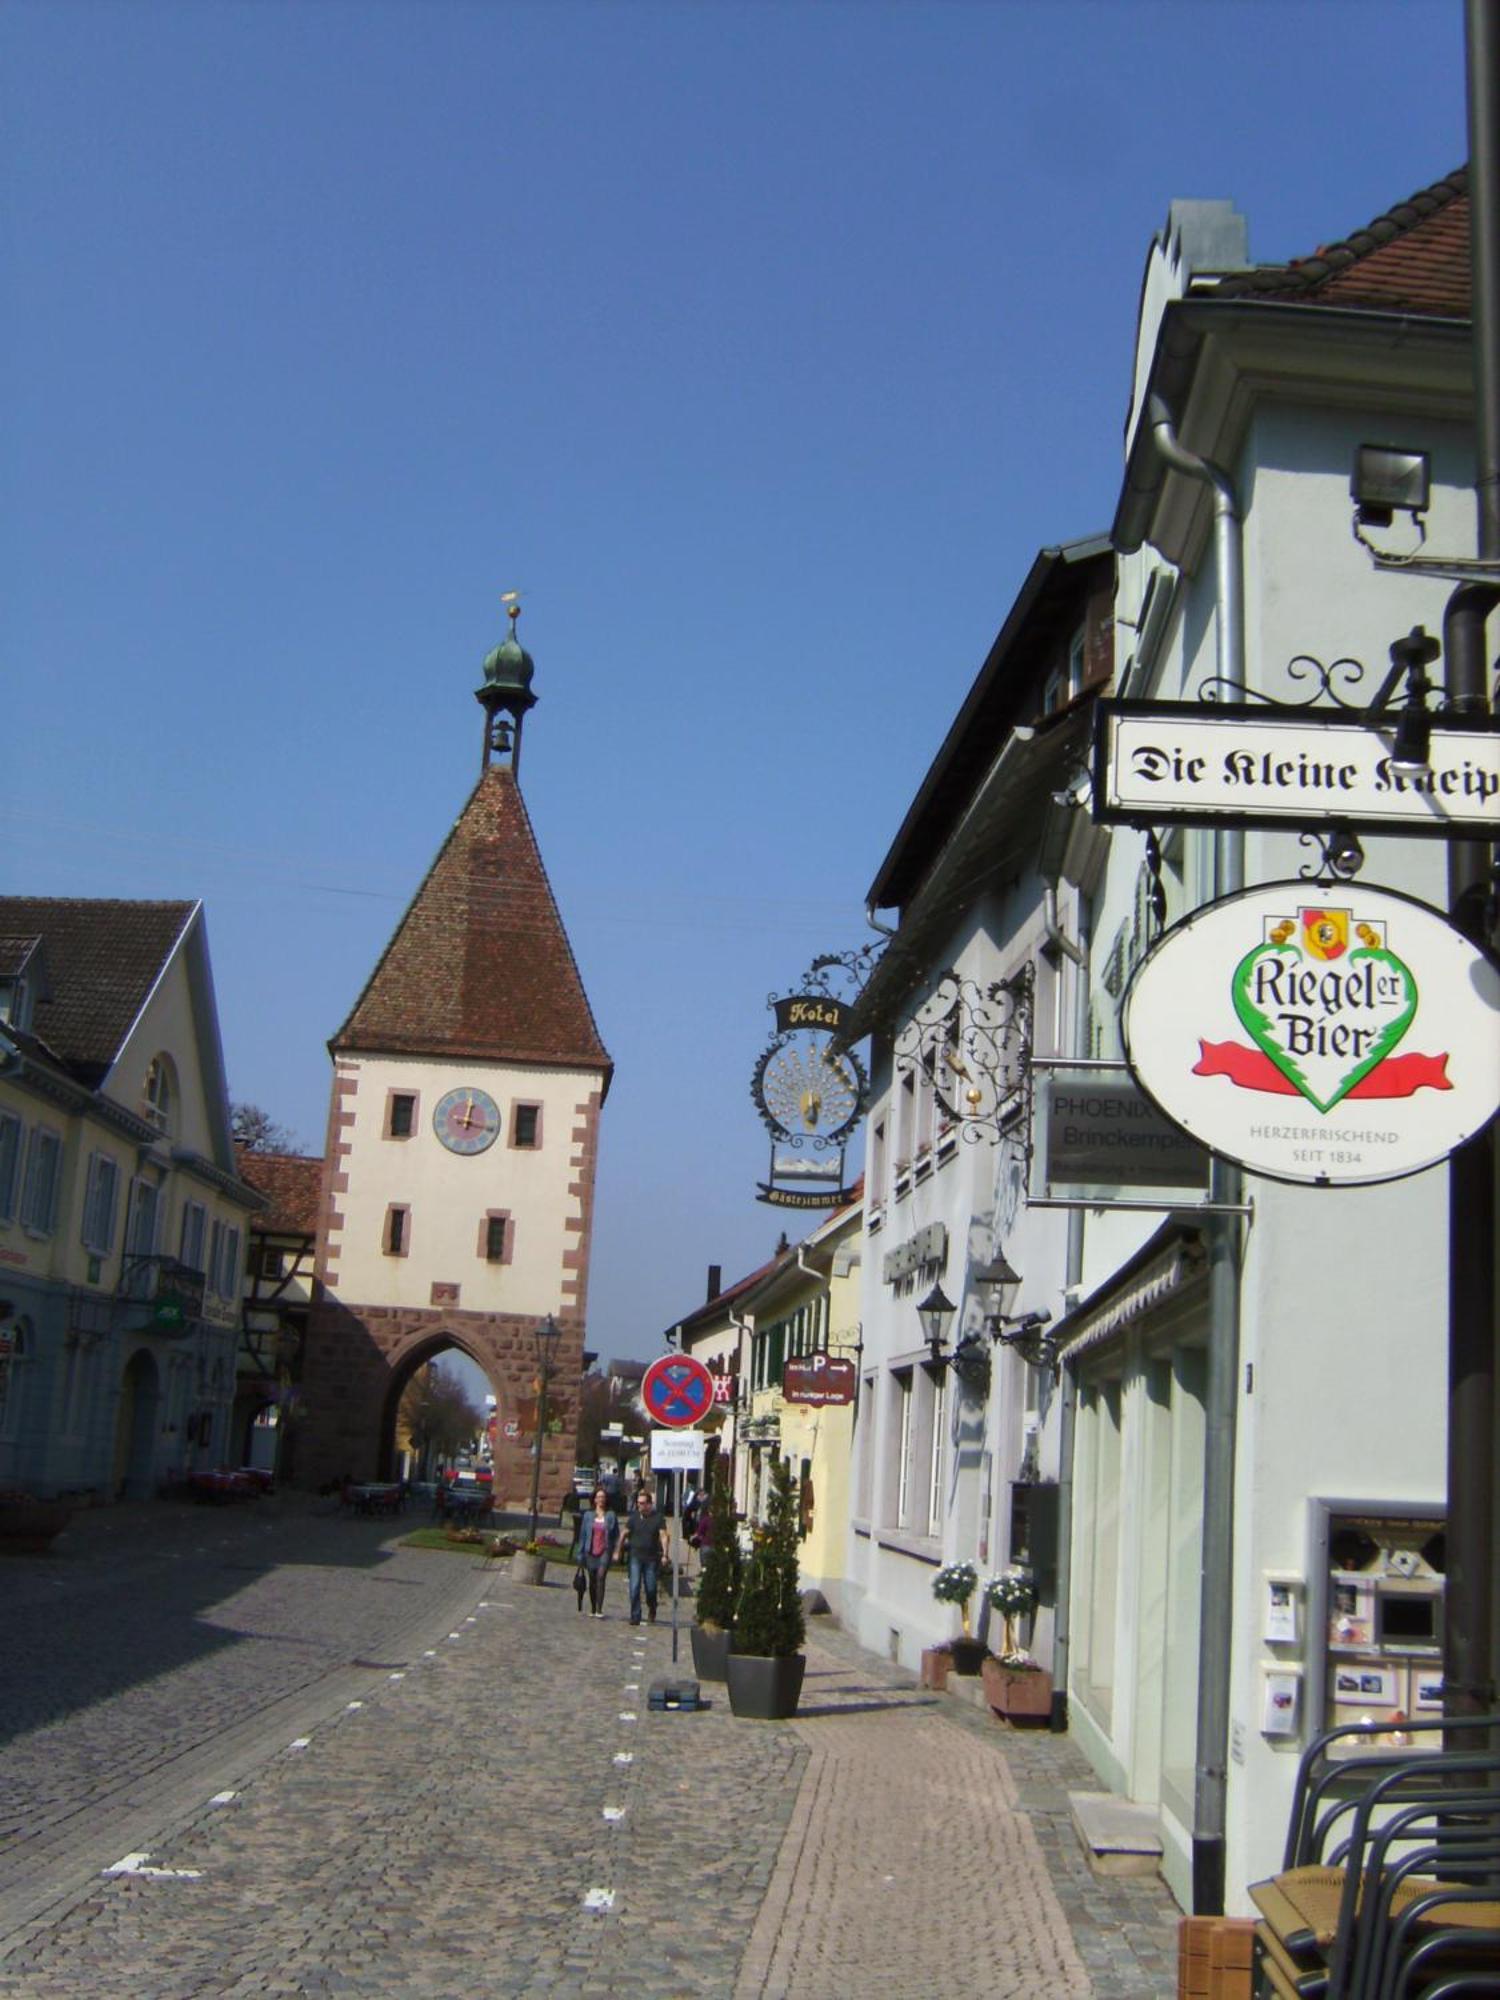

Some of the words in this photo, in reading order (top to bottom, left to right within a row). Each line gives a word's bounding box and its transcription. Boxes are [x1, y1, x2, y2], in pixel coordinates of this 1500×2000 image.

[1131, 745, 1207, 784] Die
[1223, 748, 1358, 791] Kleine
[1254, 957, 1401, 1016] Riegeler
[788, 1002, 840, 1026] Hotel
[1277, 1013, 1377, 1058] Bier
[1053, 1096, 1153, 1119] PHOENIX
[1249, 1125, 1400, 1145] HERZERFRISCHEND
[1292, 1149, 1324, 1163] SEIT
[1329, 1150, 1362, 1165] 1834
[813, 1355, 826, 1372] P
